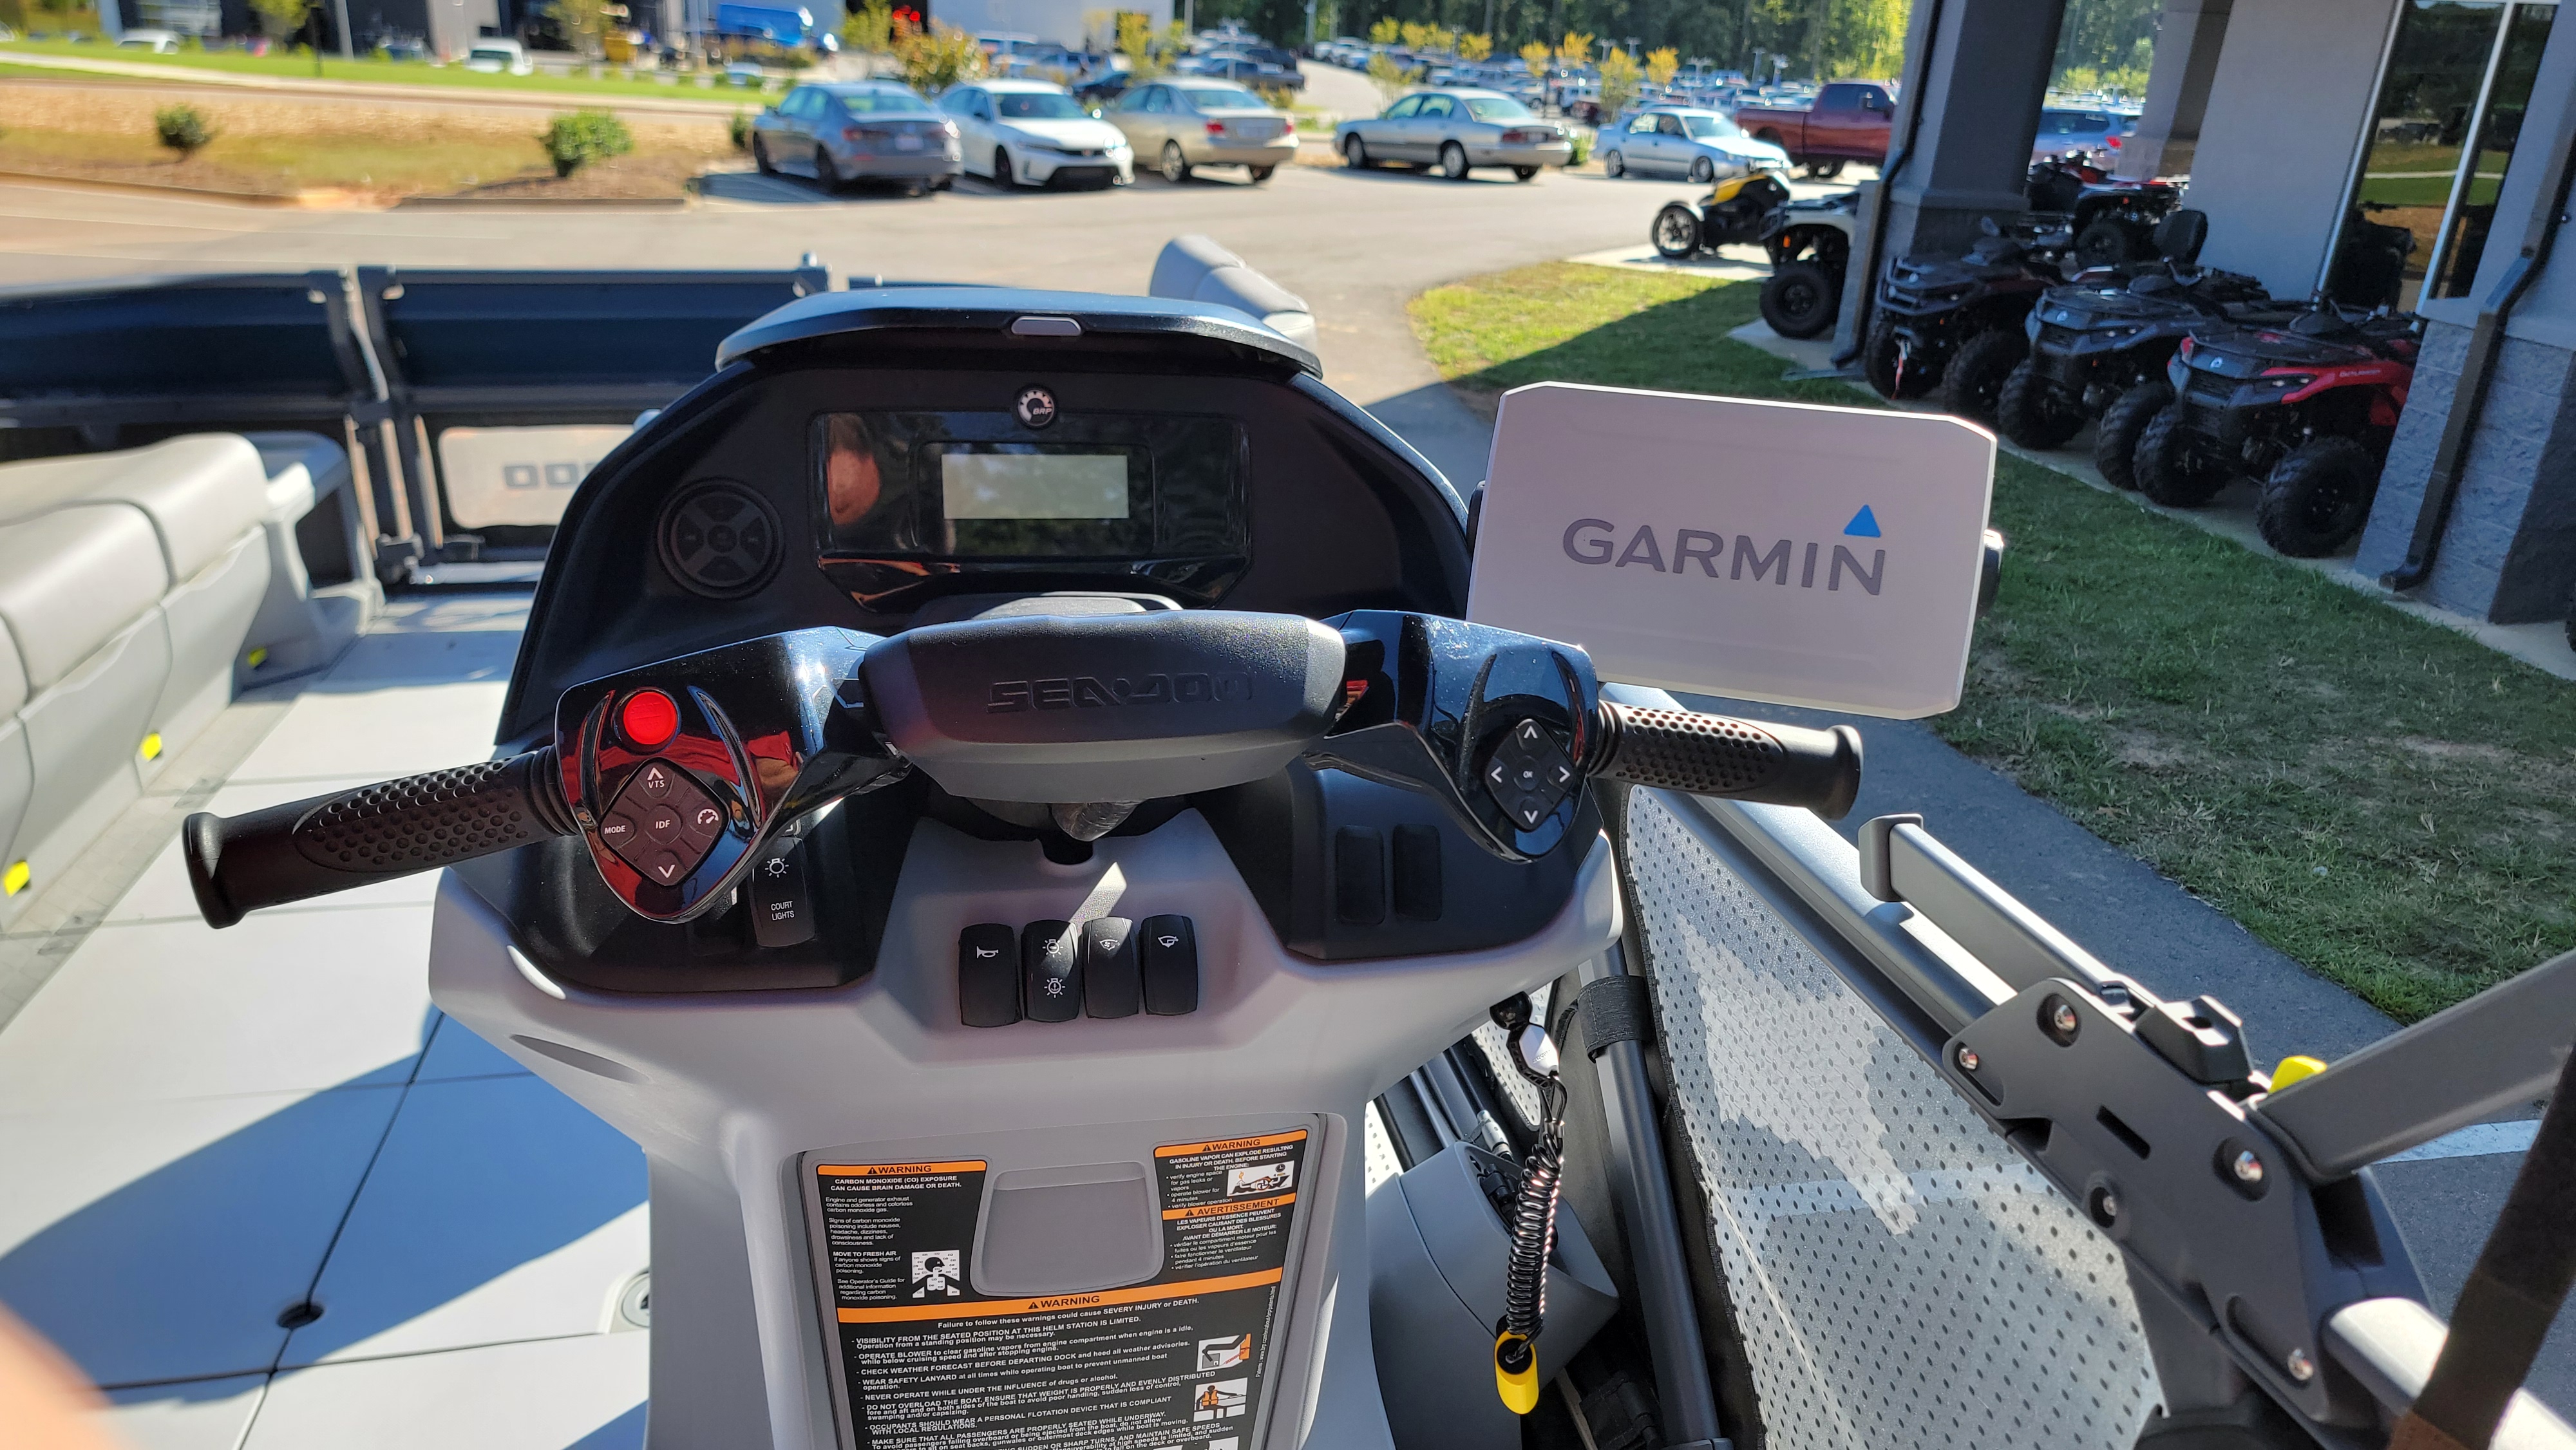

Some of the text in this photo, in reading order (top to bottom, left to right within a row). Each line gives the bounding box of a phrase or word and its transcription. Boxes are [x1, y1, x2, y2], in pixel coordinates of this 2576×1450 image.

[1562, 518, 1886, 596] GARMIN
[1522, 770, 1533, 779] OK
[648, 780, 665, 789] VTS
[604, 825, 626, 834] MODE
[655, 819, 671, 829] IDF
[771, 901, 793, 911] COURT
[772, 910, 795, 921] LIGHTS
[1212, 1139, 1260, 1151] WARNING
[1169, 1156, 1199, 1164] GASOLINE
[1235, 1148, 1261, 1157] EXPLODE
[1262, 1144, 1293, 1153] RESULTING
[1235, 1155, 1258, 1163] BEFORE
[1259, 1151, 1287, 1160] STARTING
[878, 1165, 932, 1174] WARNING
[1197, 1198, 1280, 1216] AVERTISSEMENT
[1189, 1216, 1215, 1224] VAPEURS
[1249, 1209, 1274, 1217] PEUVENT
[1177, 1223, 1207, 1231] EXPLOSER
[1208, 1219, 1235, 1227] CAUSANT
[1041, 1295, 1100, 1308] WARNING
[1021, 1313, 1055, 1324] warnings
[1103, 1306, 1132, 1315] SEVERY
[1135, 1303, 1160, 1312] INJURY
[1173, 1297, 1199, 1307] DEATH.
[856, 1336, 895, 1344] VISIBILITY
[940, 1331, 971, 1340] SEATED
[972, 1328, 1009, 1337] POSITION
[1043, 1323, 1064, 1332] HELM
[1066, 1320, 1097, 1330] STATION
[1109, 1315, 1141, 1325] LIMITED.
[897, 1350, 931, 1358] BLOWER
[963, 1345, 994, 1355] gasoline
[996, 1344, 1021, 1353] vapors
[1042, 1339, 1066, 1349] engine
[1069, 1333, 1116, 1346] compartment
[1118, 1331, 1137, 1339] when
[1139, 1328, 1162, 1339] engine
[890, 1365, 929, 1373] WEATHER
[931, 1362, 971, 1371] FORECAST
[974, 1360, 1006, 1368] BEFORE
[1008, 1355, 1052, 1366] DEPARTING
[1054, 1353, 1075, 1361] DOCK
[1122, 1344, 1150, 1354] weather
[1152, 1339, 1189, 1350] advisories.
[920, 1373, 956, 1382] LANYARD
[1021, 1365, 1055, 1376] operating
[1084, 1359, 1111, 1370] prevent
[1113, 1354, 1150, 1365] unmanned
[863, 1382, 900, 1391] operation.
[1004, 1382, 1046, 1392] INFLUENCE
[1057, 1378, 1078, 1388] drugs
[1090, 1373, 1117, 1383] alcohol.
[869, 1422, 916, 1431] OCCUPANTS
[918, 1419, 950, 1427] SHOULD
[984, 1413, 1025, 1422] PERSONAL
[1027, 1408, 1068, 1418] FLOTATION
[1070, 1405, 1097, 1414] DEVICE
[1100, 1402, 1118, 1411] THAT
[1129, 1395, 1171, 1407] COMPLIANT
